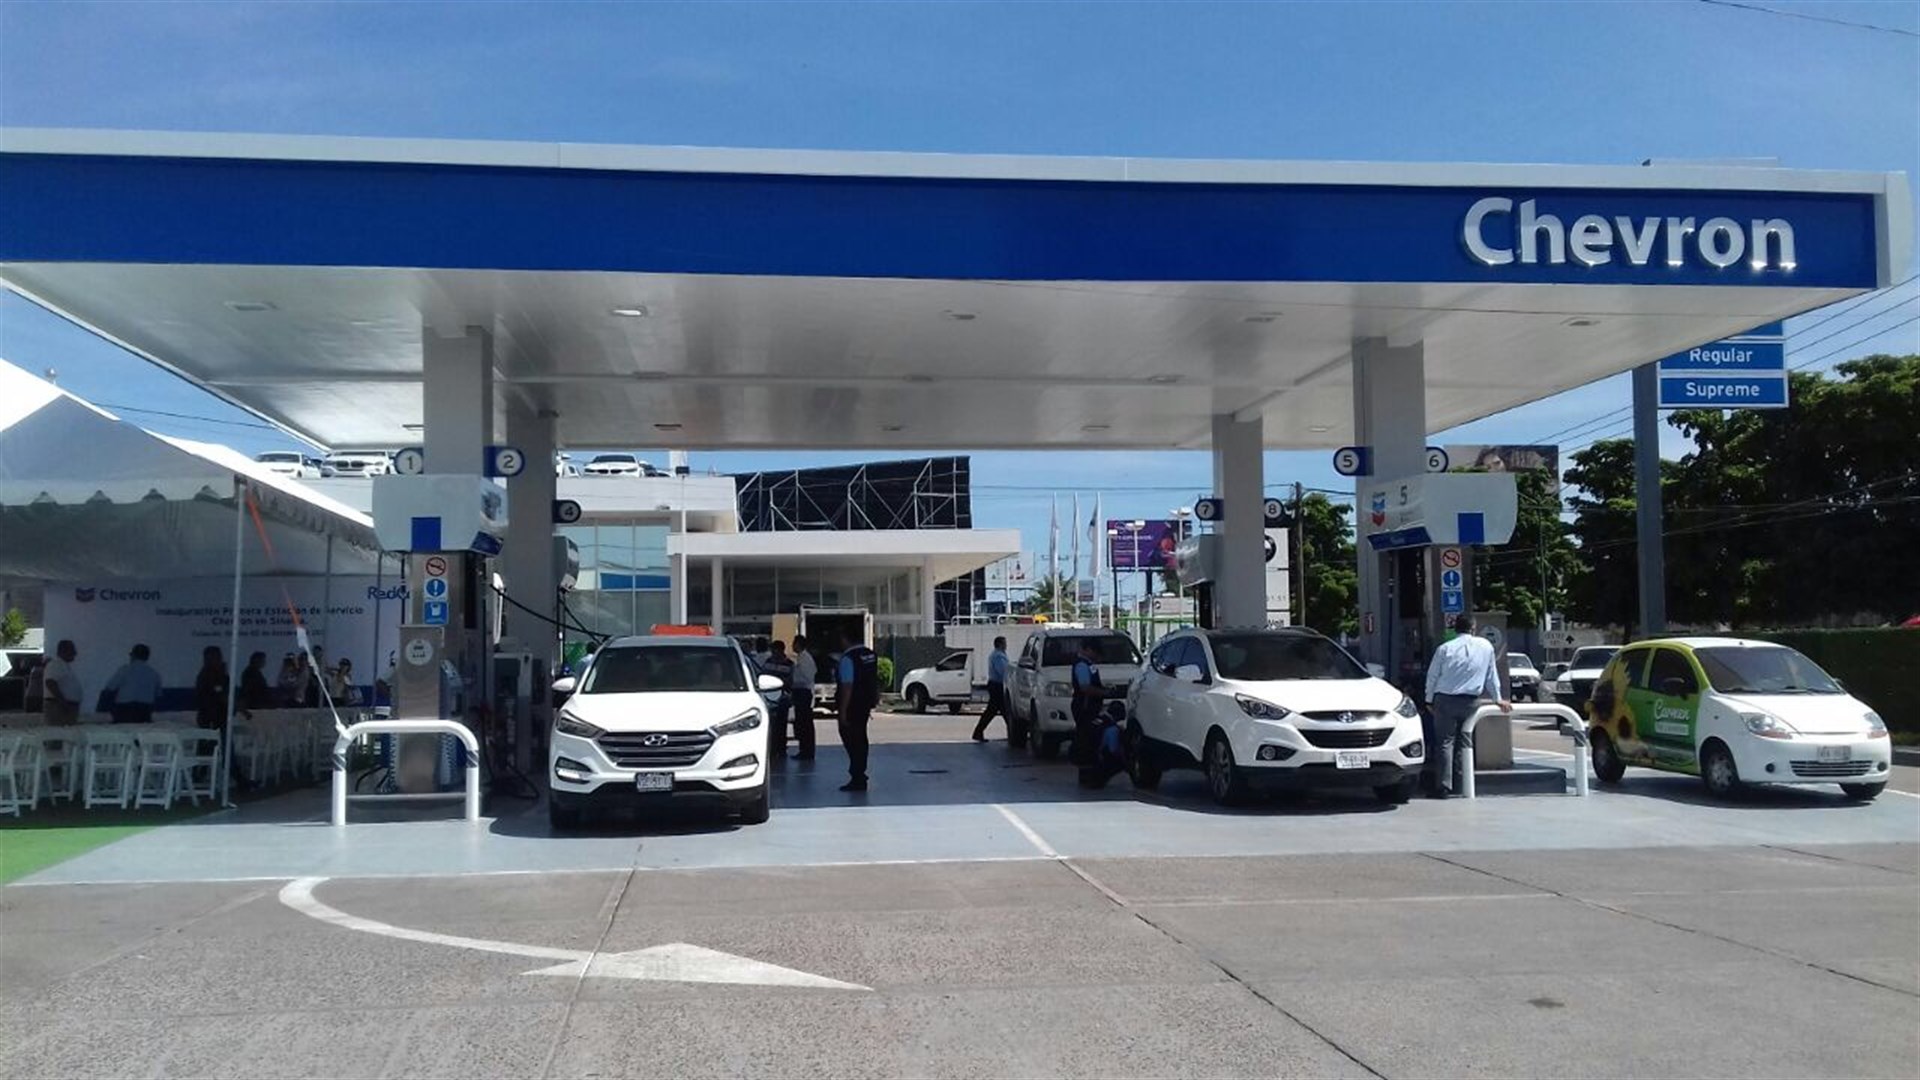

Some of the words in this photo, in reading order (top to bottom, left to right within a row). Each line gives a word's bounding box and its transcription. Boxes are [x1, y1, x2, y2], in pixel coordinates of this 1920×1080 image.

[1463, 197, 1796, 268] Chevron
[1689, 347, 1753, 365] Regular
[1685, 382, 1760, 399] Supreme
[406, 456, 413, 470] 1
[503, 455, 514, 469] 2
[1343, 455, 1353, 468] 5
[1429, 455, 1439, 468] 6
[1400, 485, 1408, 505] 5
[565, 506, 573, 517] 4
[1201, 505, 1210, 516] 7
[1268, 504, 1277, 515] 8
[100, 588, 161, 601] Chevron
